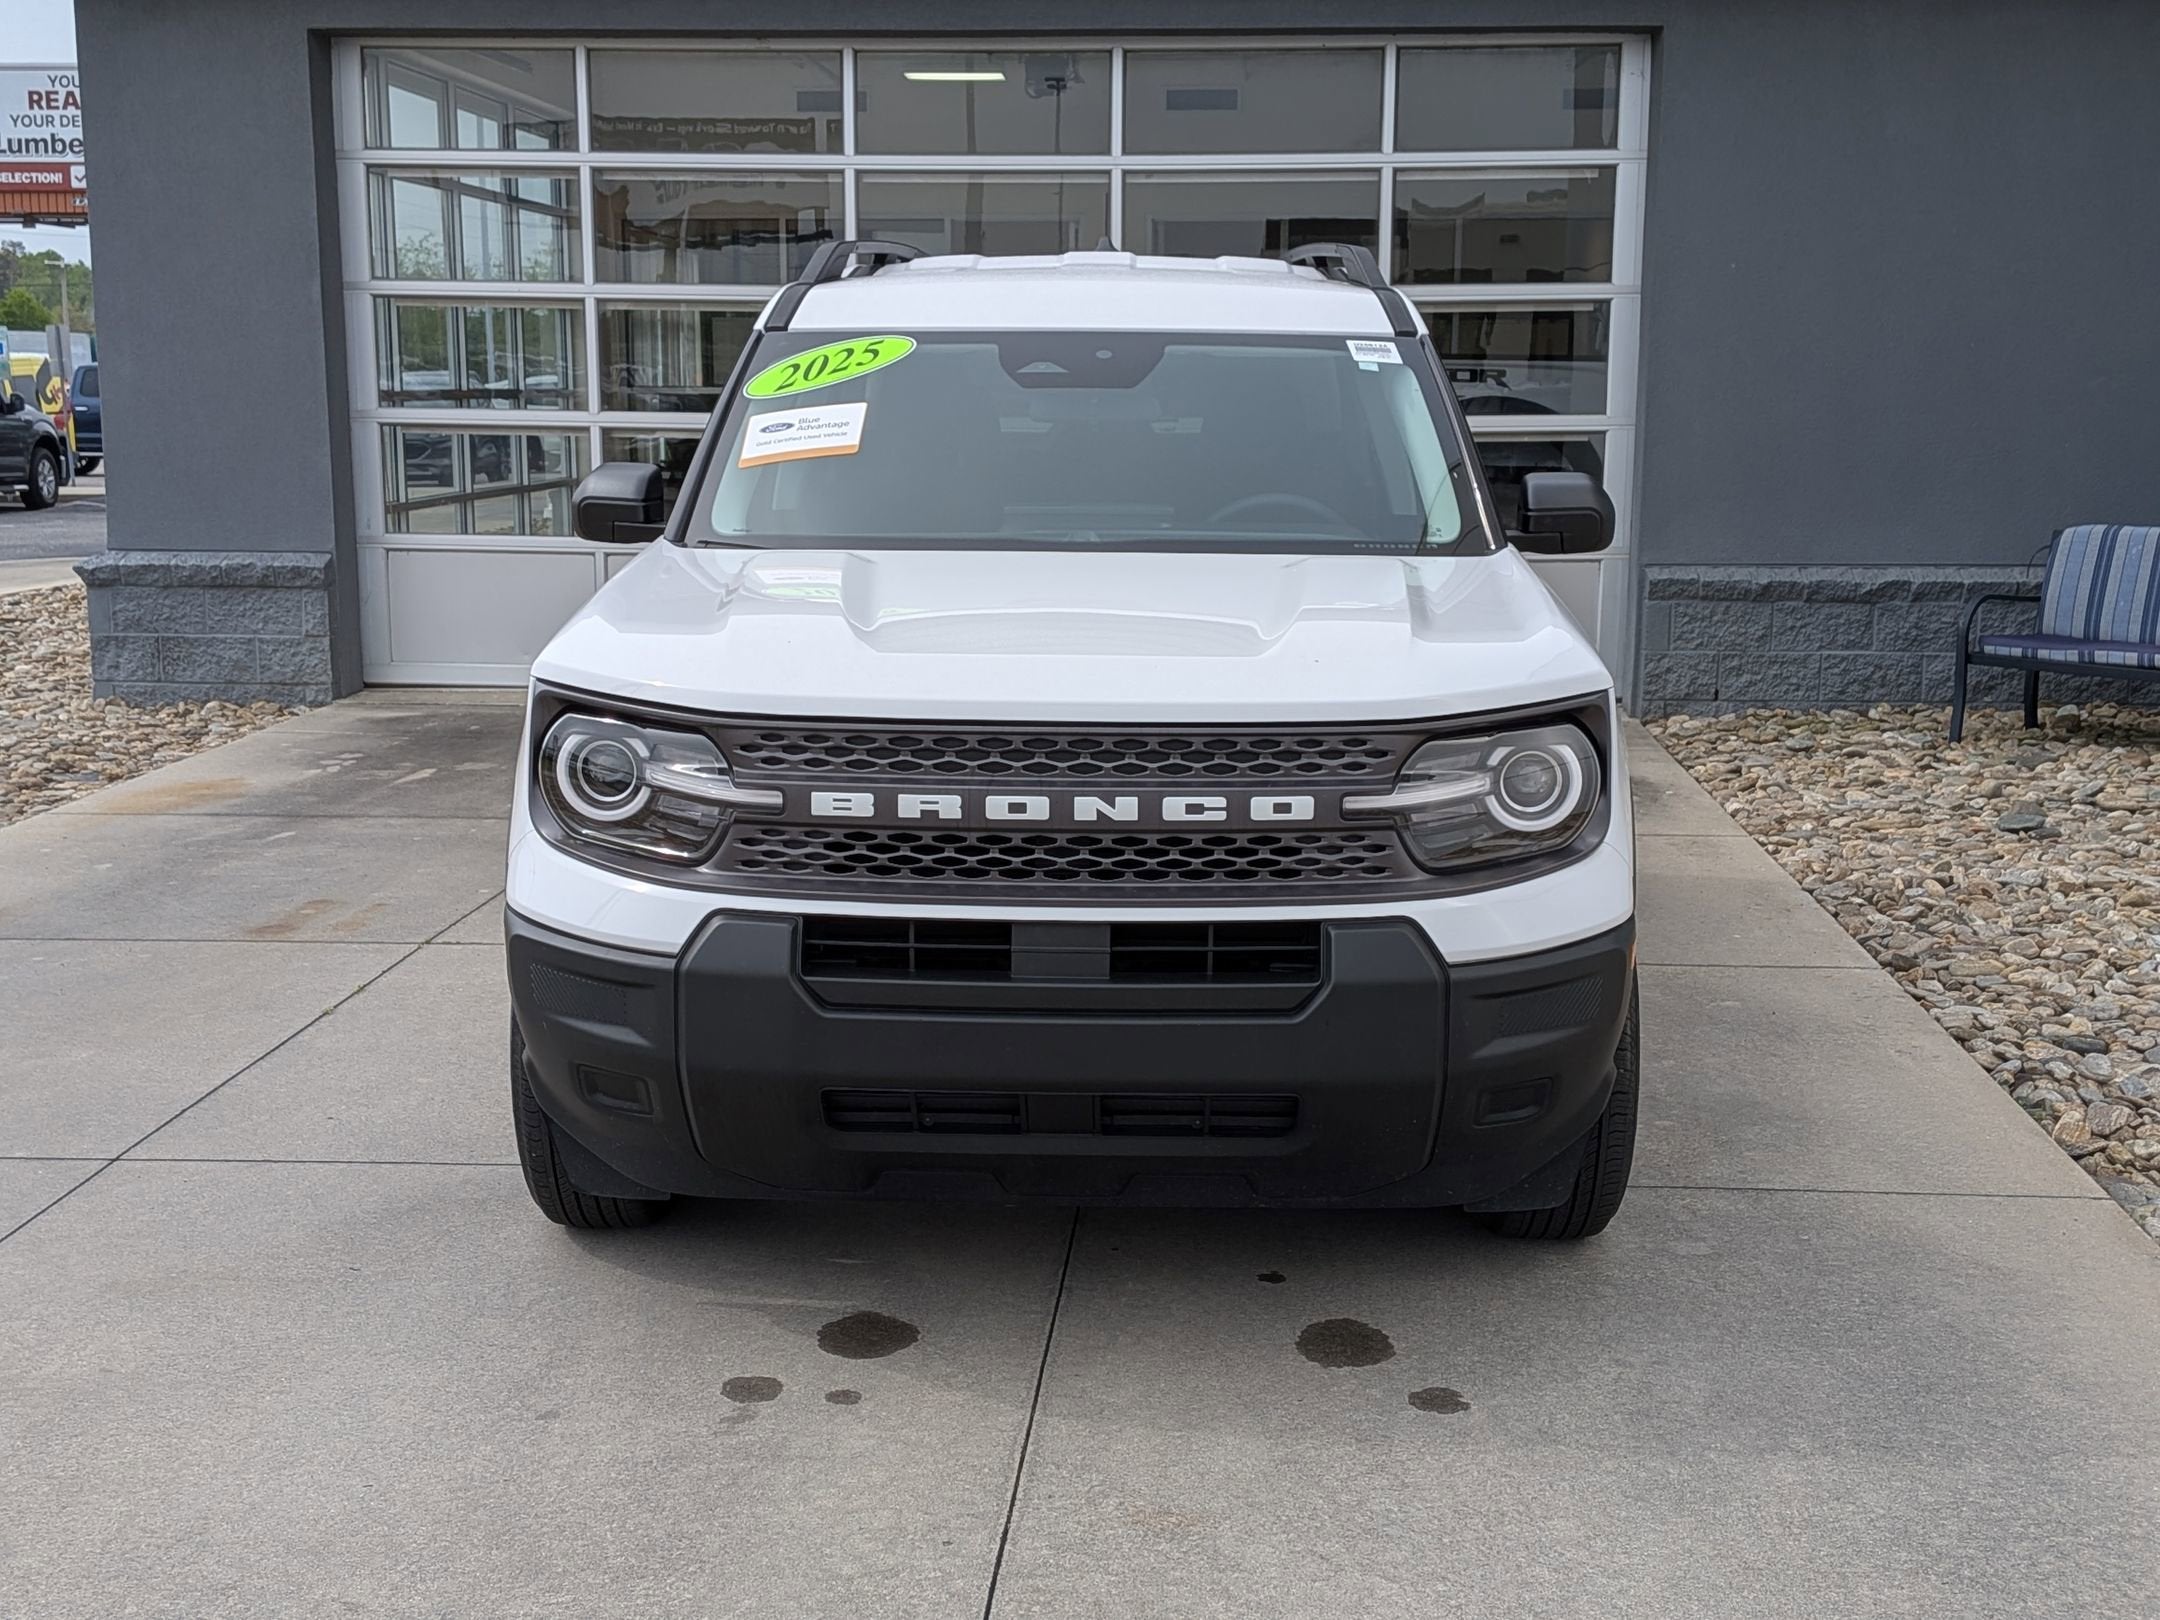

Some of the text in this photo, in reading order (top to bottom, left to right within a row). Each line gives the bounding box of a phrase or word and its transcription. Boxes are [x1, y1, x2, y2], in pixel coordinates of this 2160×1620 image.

[27, 90, 81, 111] REA
[10, 114, 81, 128] YOUR DE
[773, 339, 887, 393] 2025
[796, 421, 850, 432] Advantage
[798, 416, 821, 425] Blue
[773, 435, 803, 444] Certified
[810, 791, 1315, 822] BRONCO
